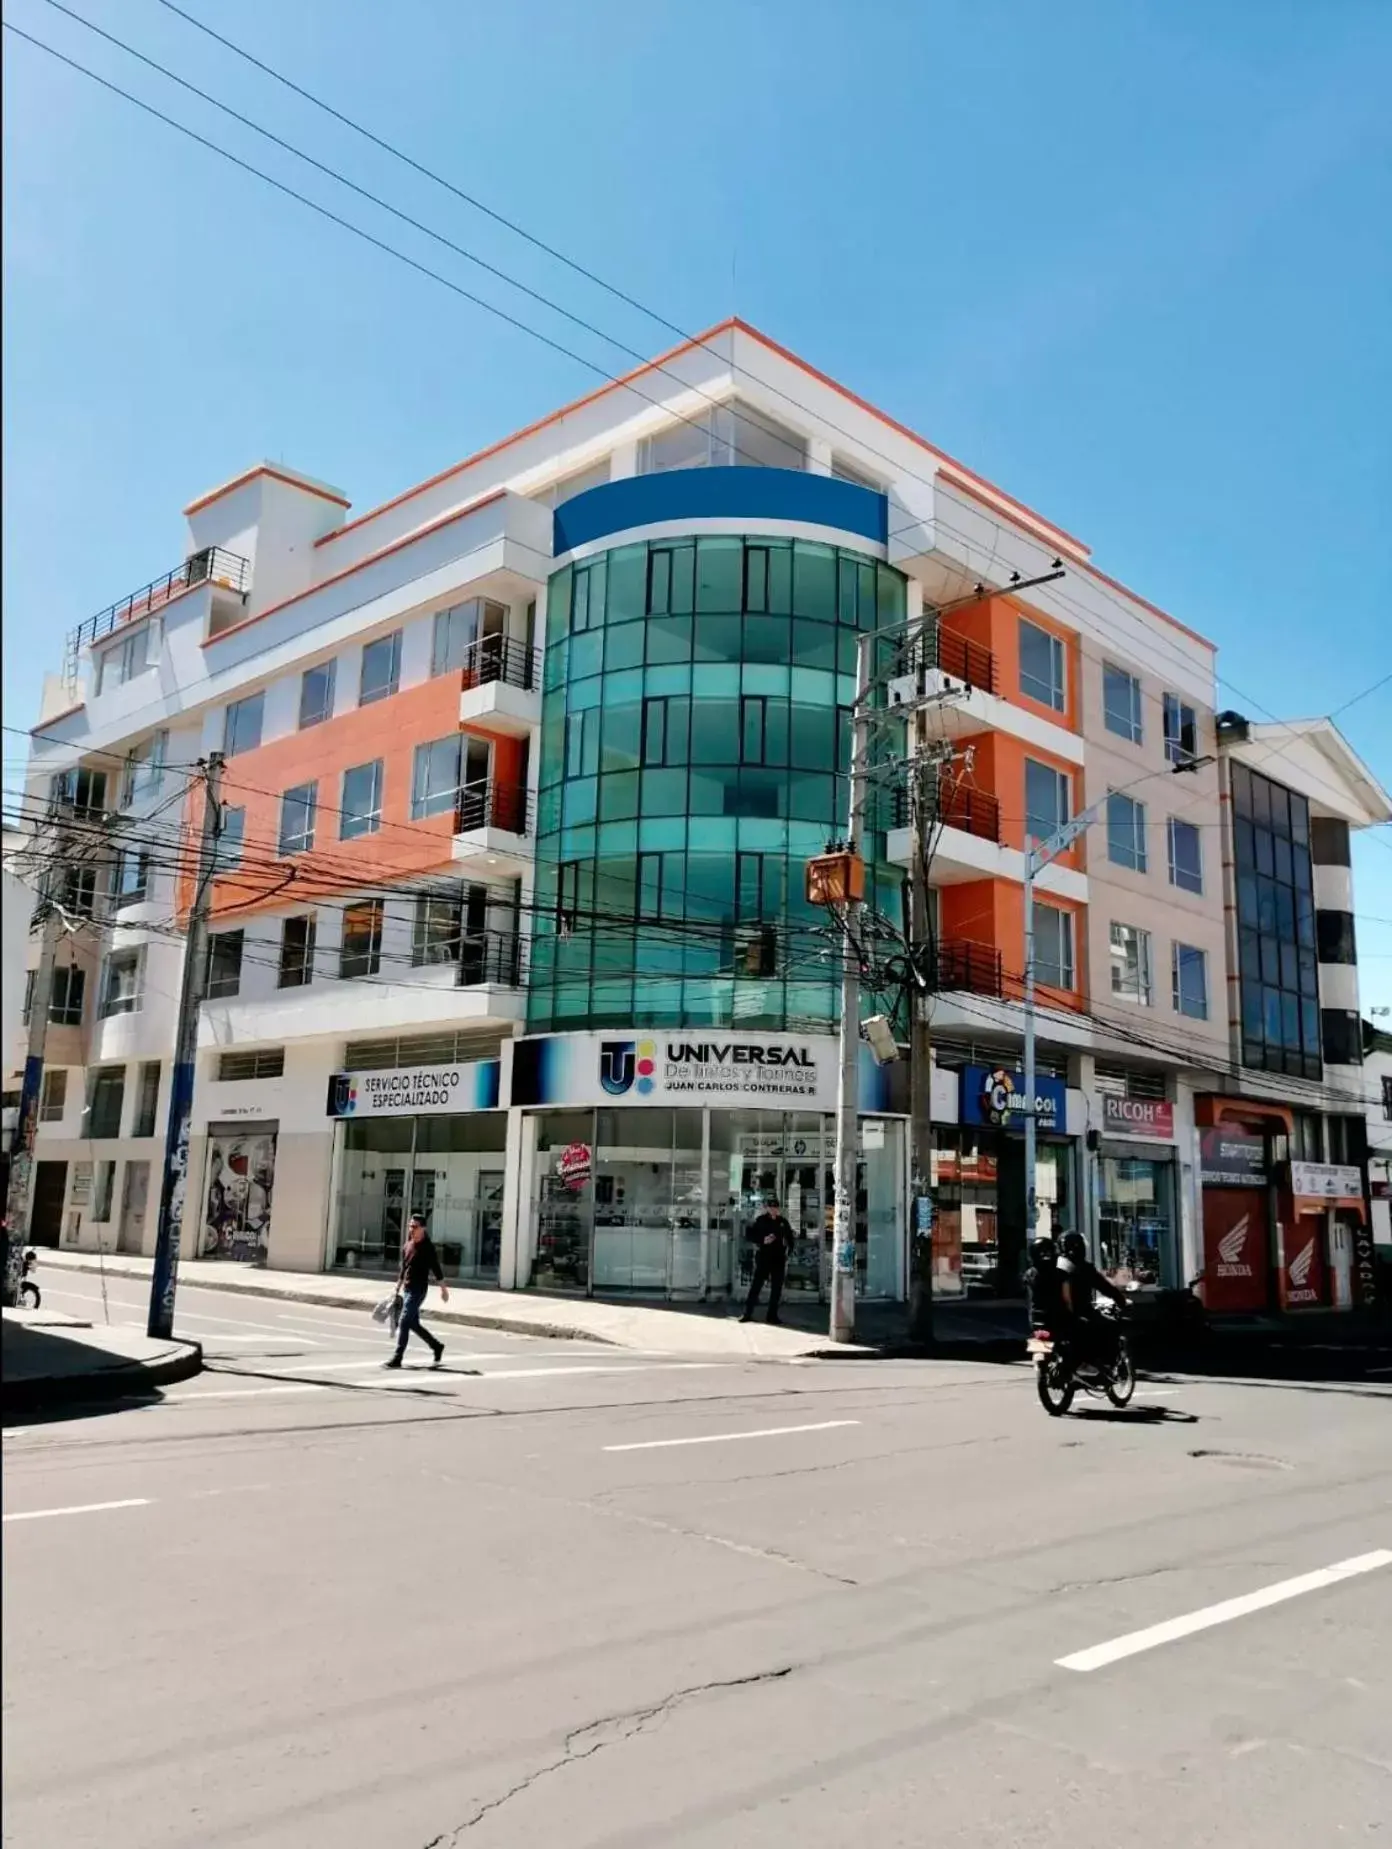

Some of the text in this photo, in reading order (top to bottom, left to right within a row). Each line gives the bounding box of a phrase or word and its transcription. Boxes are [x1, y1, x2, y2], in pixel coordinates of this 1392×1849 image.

[667, 1043, 815, 1067] UNIVERSAL
[664, 1063, 689, 1077] De
[364, 1071, 460, 1092] SERVICIO TÉCNICO
[665, 1081, 694, 1091] JUAN
[698, 1081, 739, 1092] CARLOS
[743, 1083, 805, 1094] CONTRERAS
[372, 1090, 450, 1108] ESPECIALIZADO
[1106, 1099, 1154, 1122] RICOH
[1217, 1263, 1252, 1277] HONDA
[1287, 1288, 1318, 1302] HONDA
